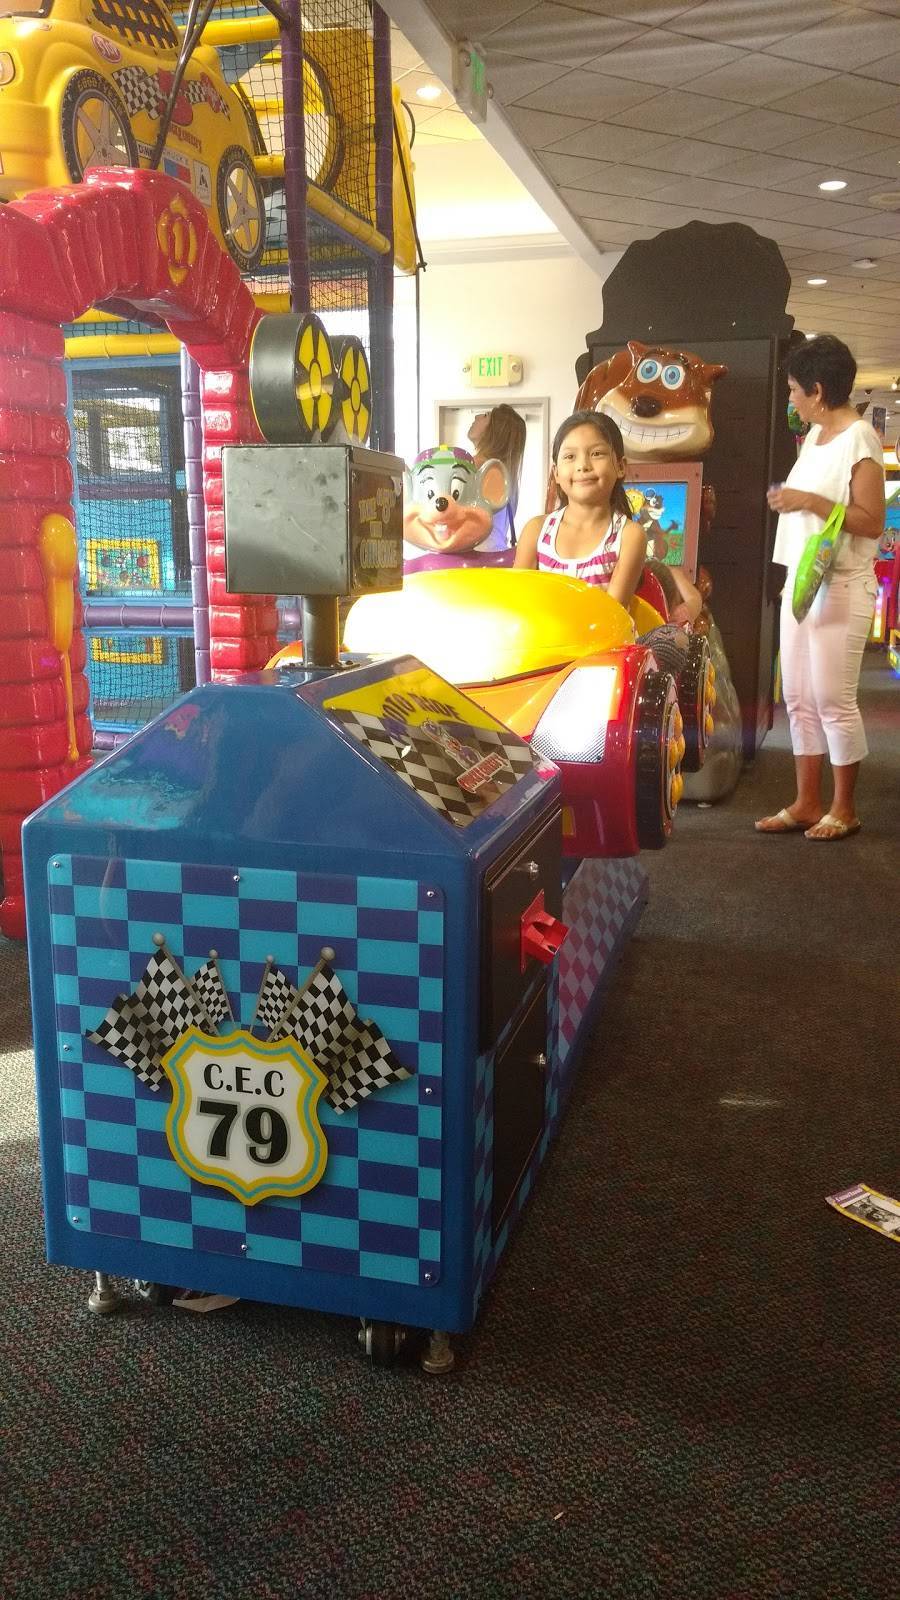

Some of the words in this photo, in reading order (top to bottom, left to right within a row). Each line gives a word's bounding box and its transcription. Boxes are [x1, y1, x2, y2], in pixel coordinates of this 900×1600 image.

[478, 357, 503, 377] EXIT
[407, 692, 469, 723] RIDE
[203, 1063, 285, 1098] C.E.C
[197, 1097, 291, 1168] 79
